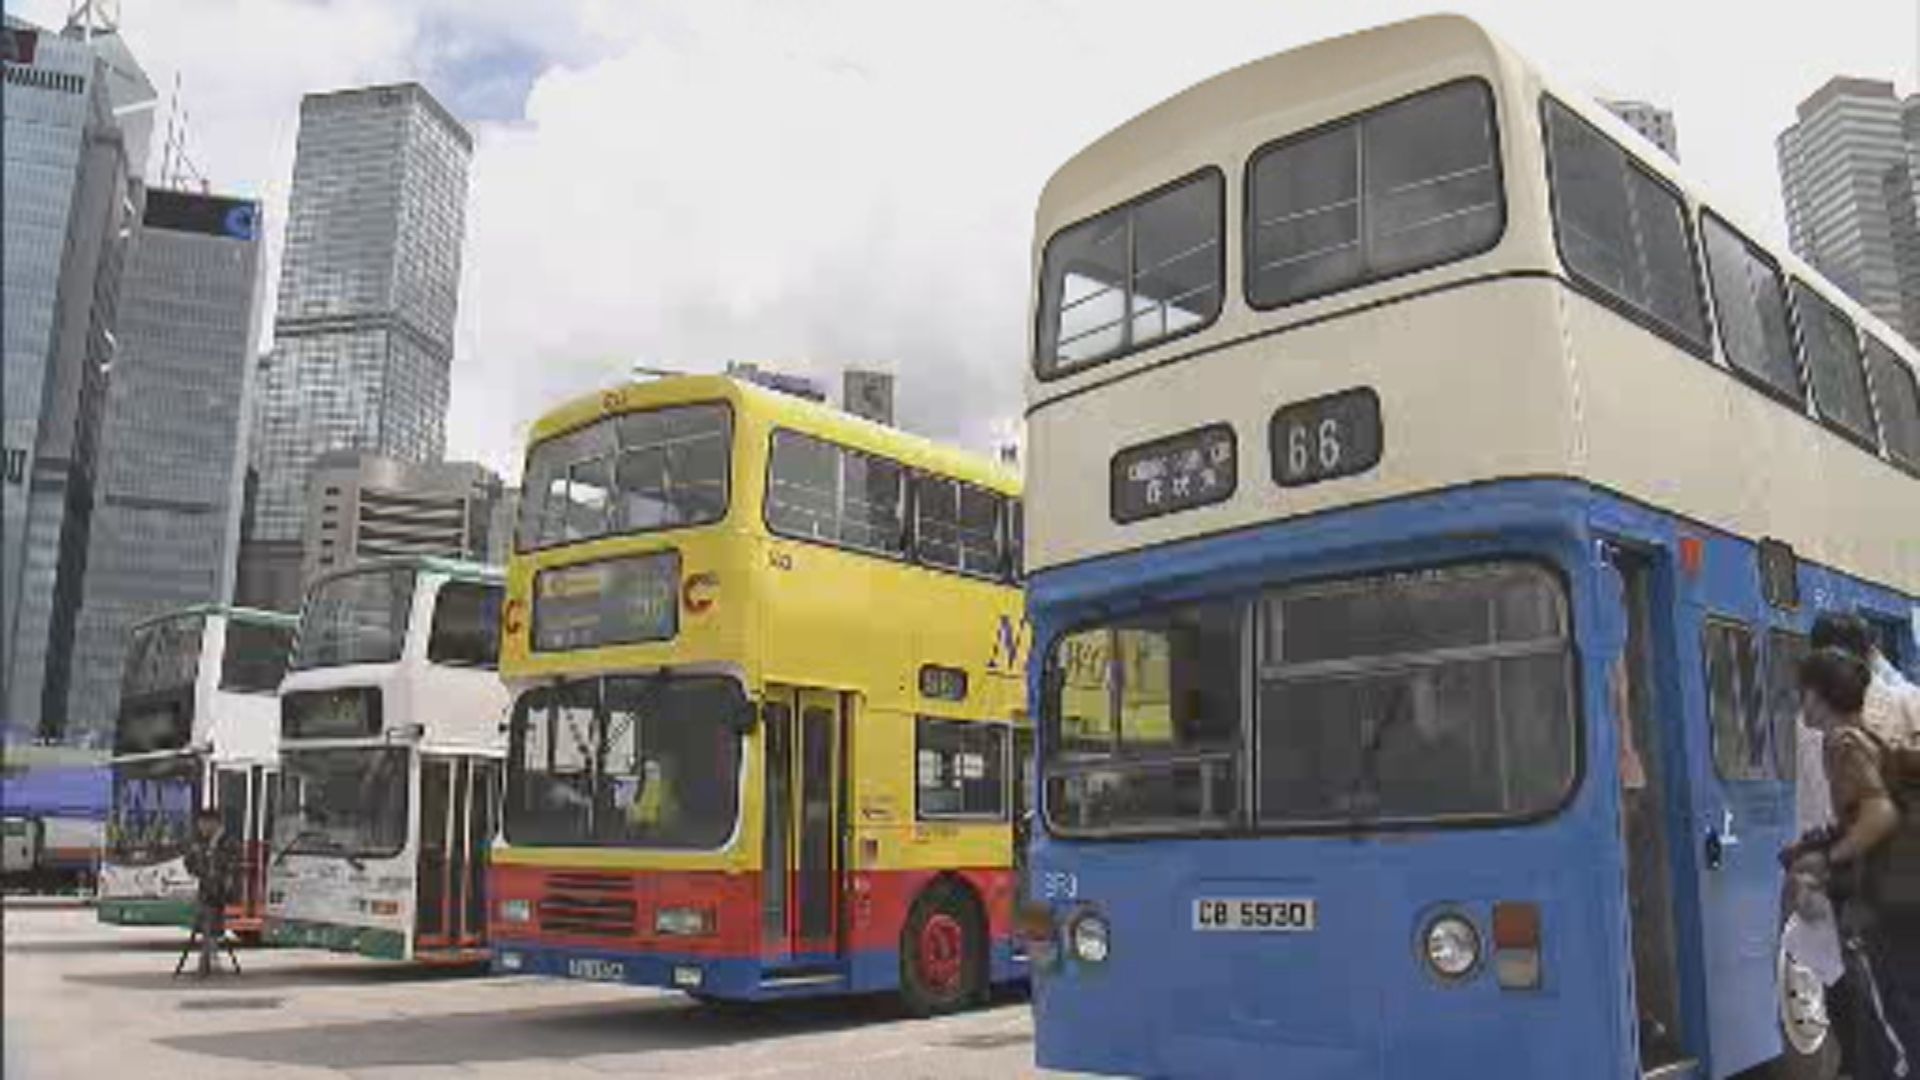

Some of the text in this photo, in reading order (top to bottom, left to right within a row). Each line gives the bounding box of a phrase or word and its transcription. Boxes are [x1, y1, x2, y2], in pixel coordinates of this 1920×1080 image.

[1289, 419, 1340, 473] 66
[1199, 901, 1306, 927] CB 5930
